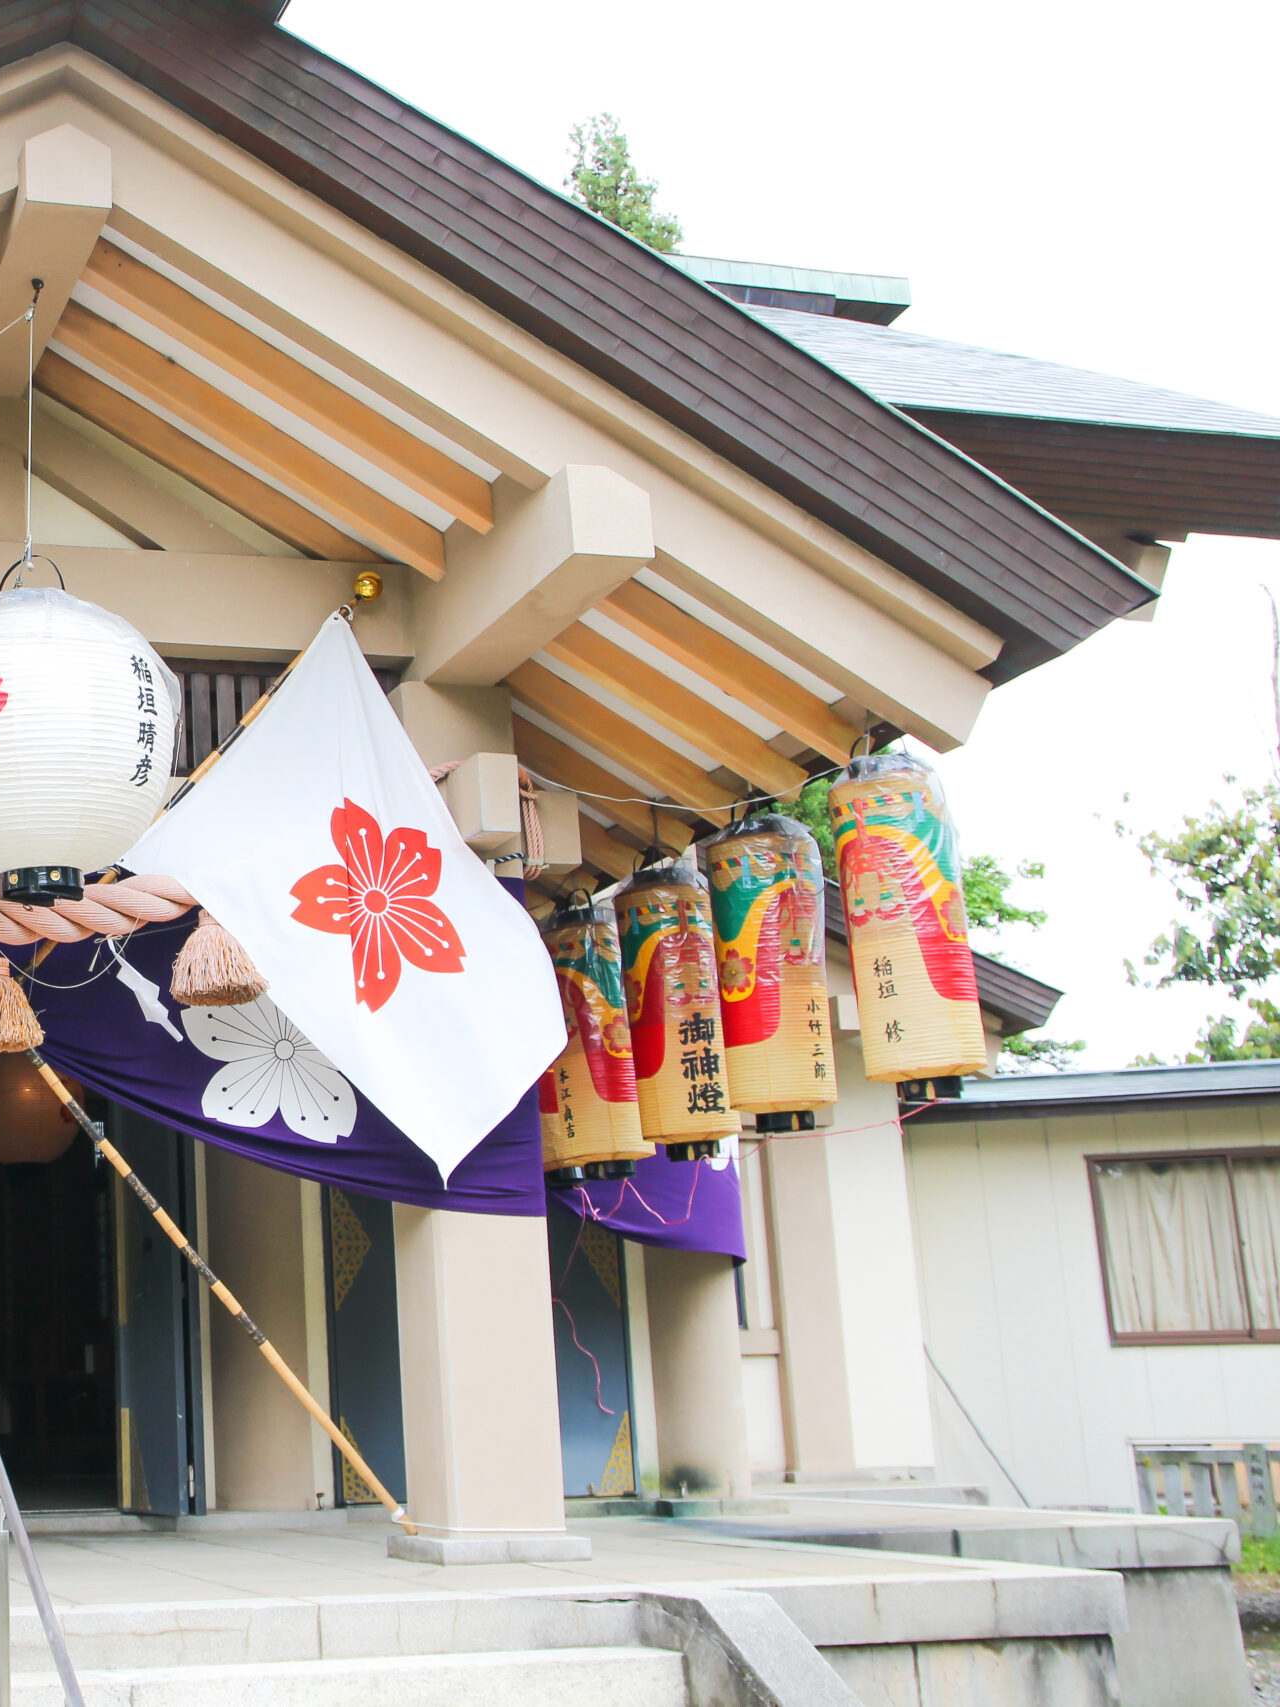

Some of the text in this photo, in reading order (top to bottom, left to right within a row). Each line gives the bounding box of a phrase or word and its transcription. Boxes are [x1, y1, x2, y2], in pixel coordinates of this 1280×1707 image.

[129, 654, 158, 787] 稲垣晴彦
[678, 1011, 726, 1114] 御神燈
[807, 999, 826, 1080] 小竹三郎
